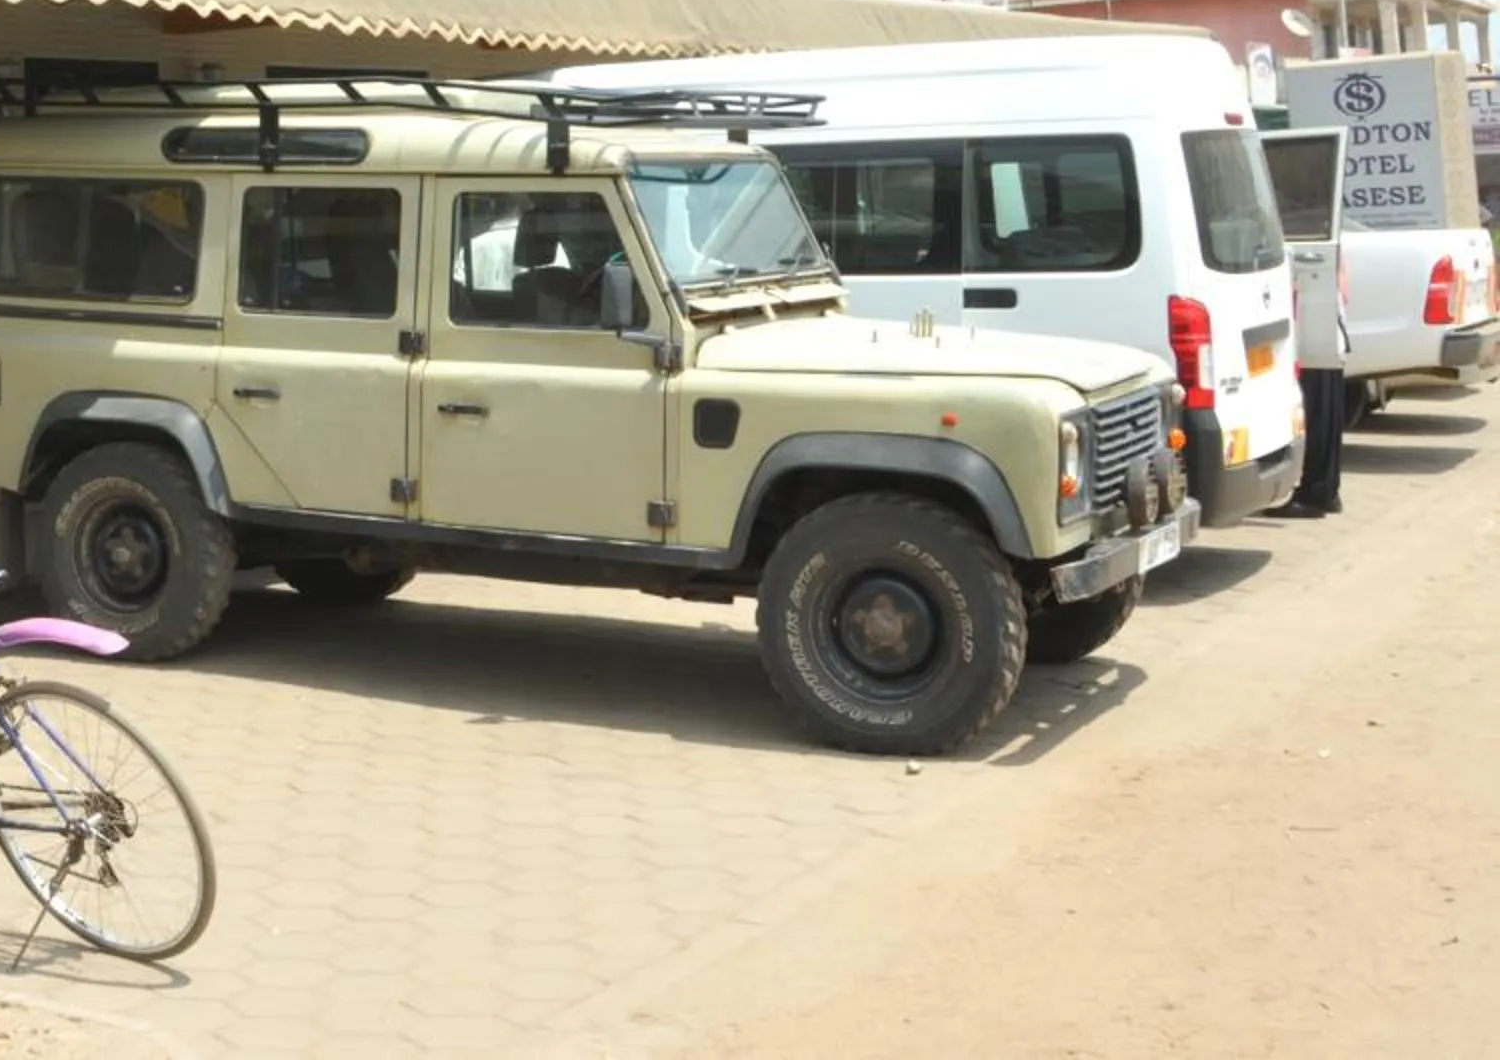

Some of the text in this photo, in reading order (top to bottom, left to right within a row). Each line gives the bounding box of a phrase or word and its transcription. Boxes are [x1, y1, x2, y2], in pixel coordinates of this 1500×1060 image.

[1351, 122, 1432, 146] DTON
[1343, 154, 1415, 178] OTEL
[1342, 185, 1426, 209] SESE
